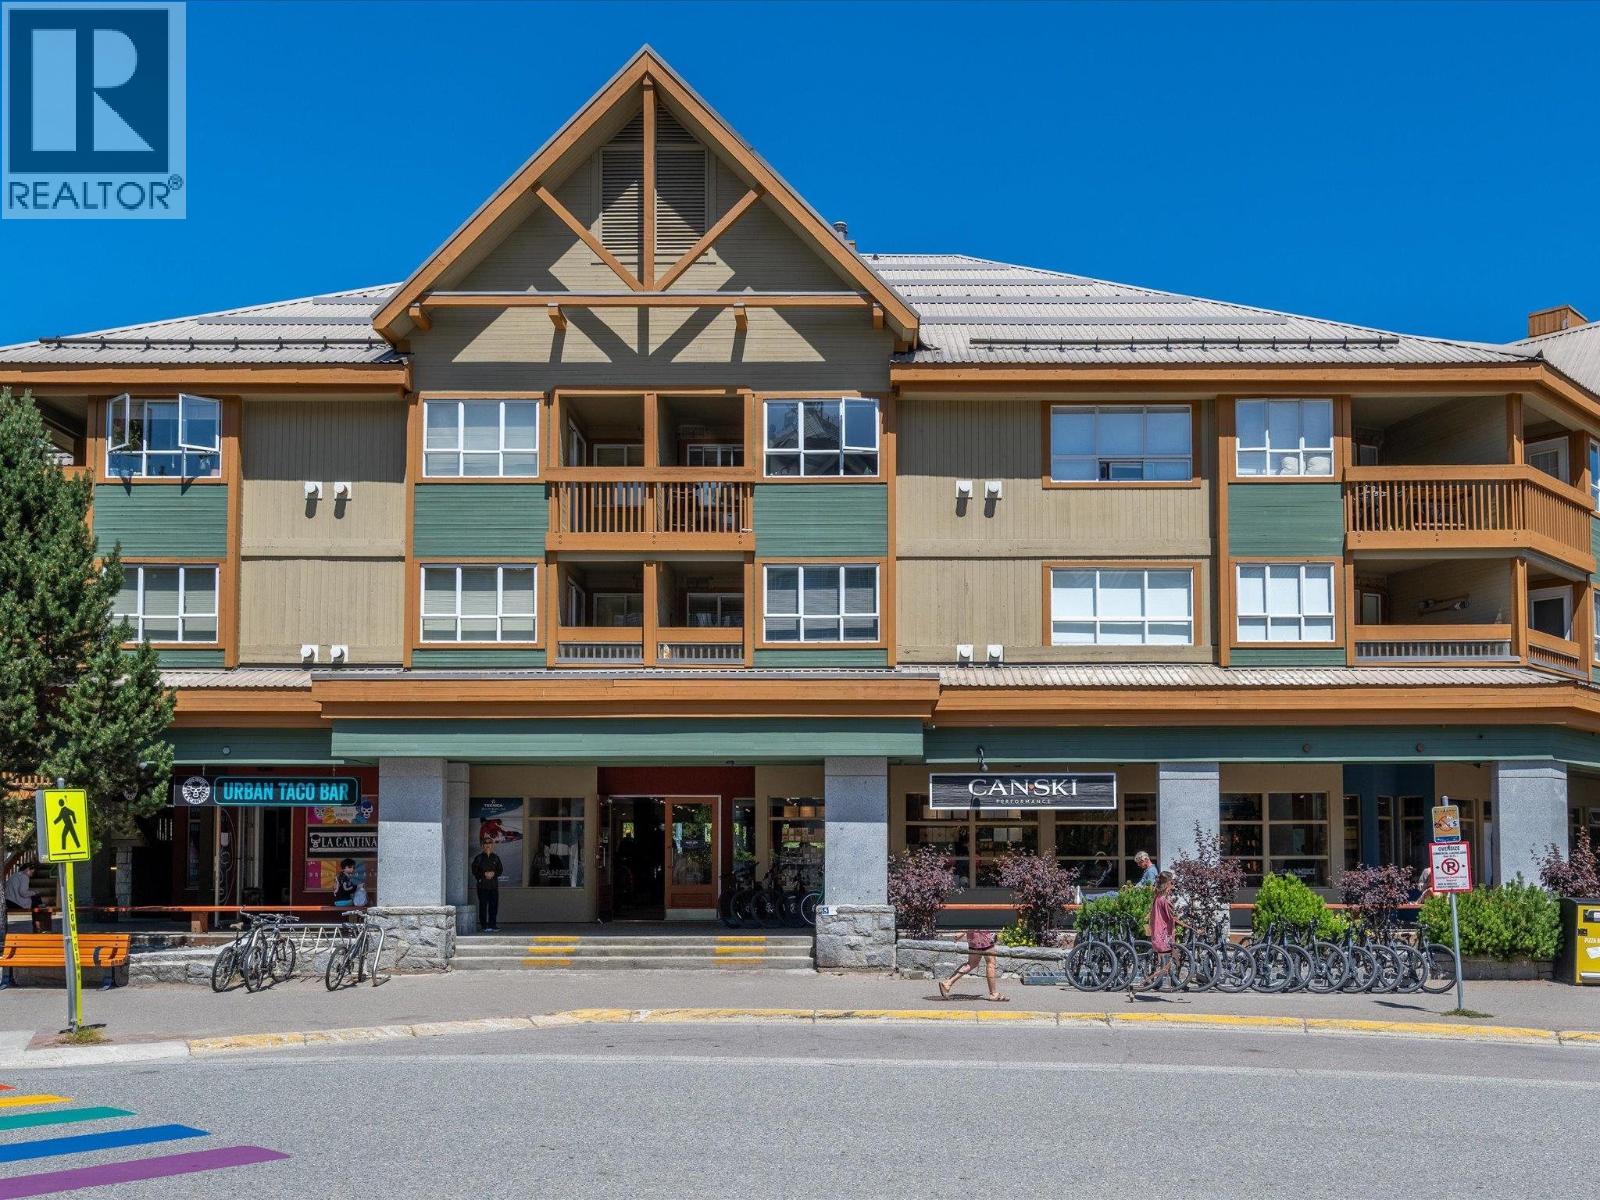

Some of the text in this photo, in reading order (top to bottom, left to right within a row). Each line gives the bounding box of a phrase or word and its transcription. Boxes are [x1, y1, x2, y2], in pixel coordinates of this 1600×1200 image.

[223, 781, 349, 801] URBAN TACO BAR
[321, 836, 378, 848] LA CANTINA
